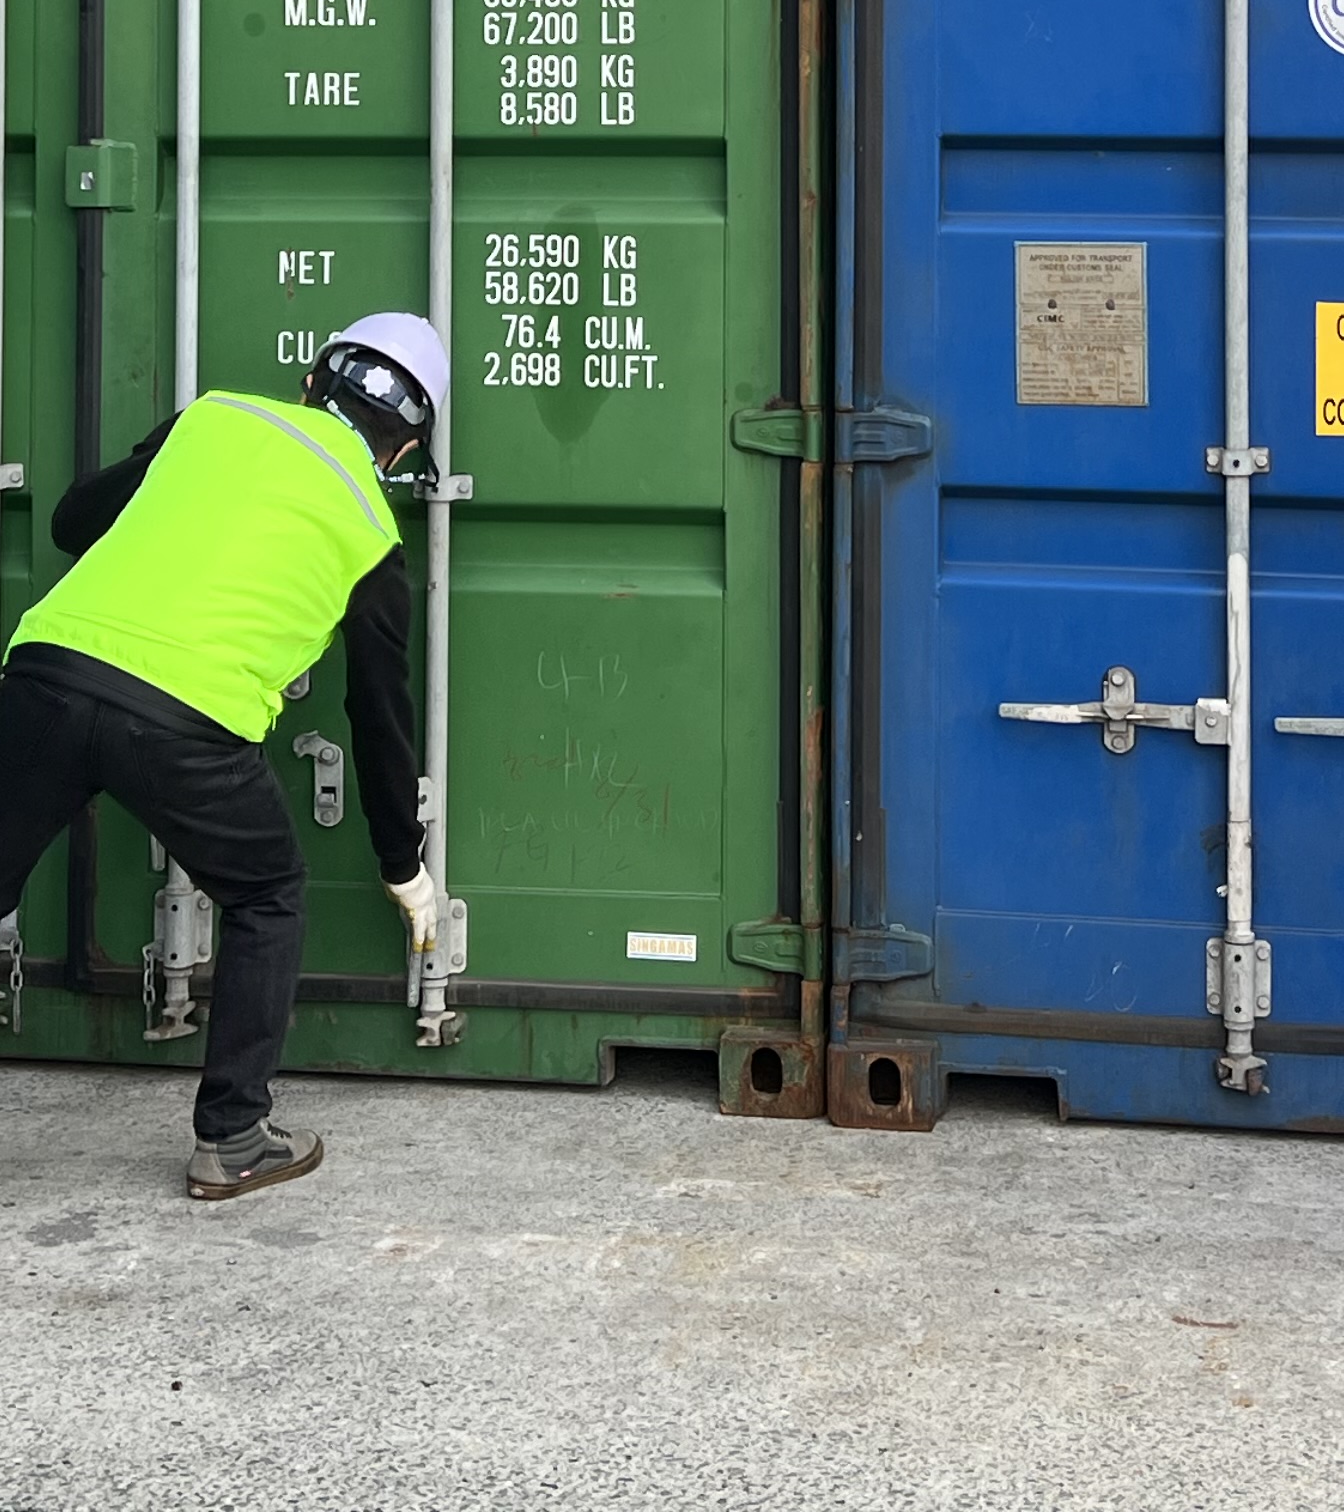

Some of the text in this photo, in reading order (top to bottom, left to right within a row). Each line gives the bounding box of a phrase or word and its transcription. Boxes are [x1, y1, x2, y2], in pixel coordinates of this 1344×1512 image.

[484, 12, 635, 44] 67,200 LB
[501, 55, 634, 88] 3,890 KG
[285, 72, 360, 107] TARE
[501, 92, 635, 125] 8,580 LB
[279, 251, 335, 284] NET
[485, 234, 636, 268] 26,590 KG
[485, 271, 636, 306] 58,620 LB
[502, 314, 651, 350] 76.4 CU.M.
[1037, 314, 1065, 323] CIMC
[484, 352, 664, 389] 2,698 CU.FT.
